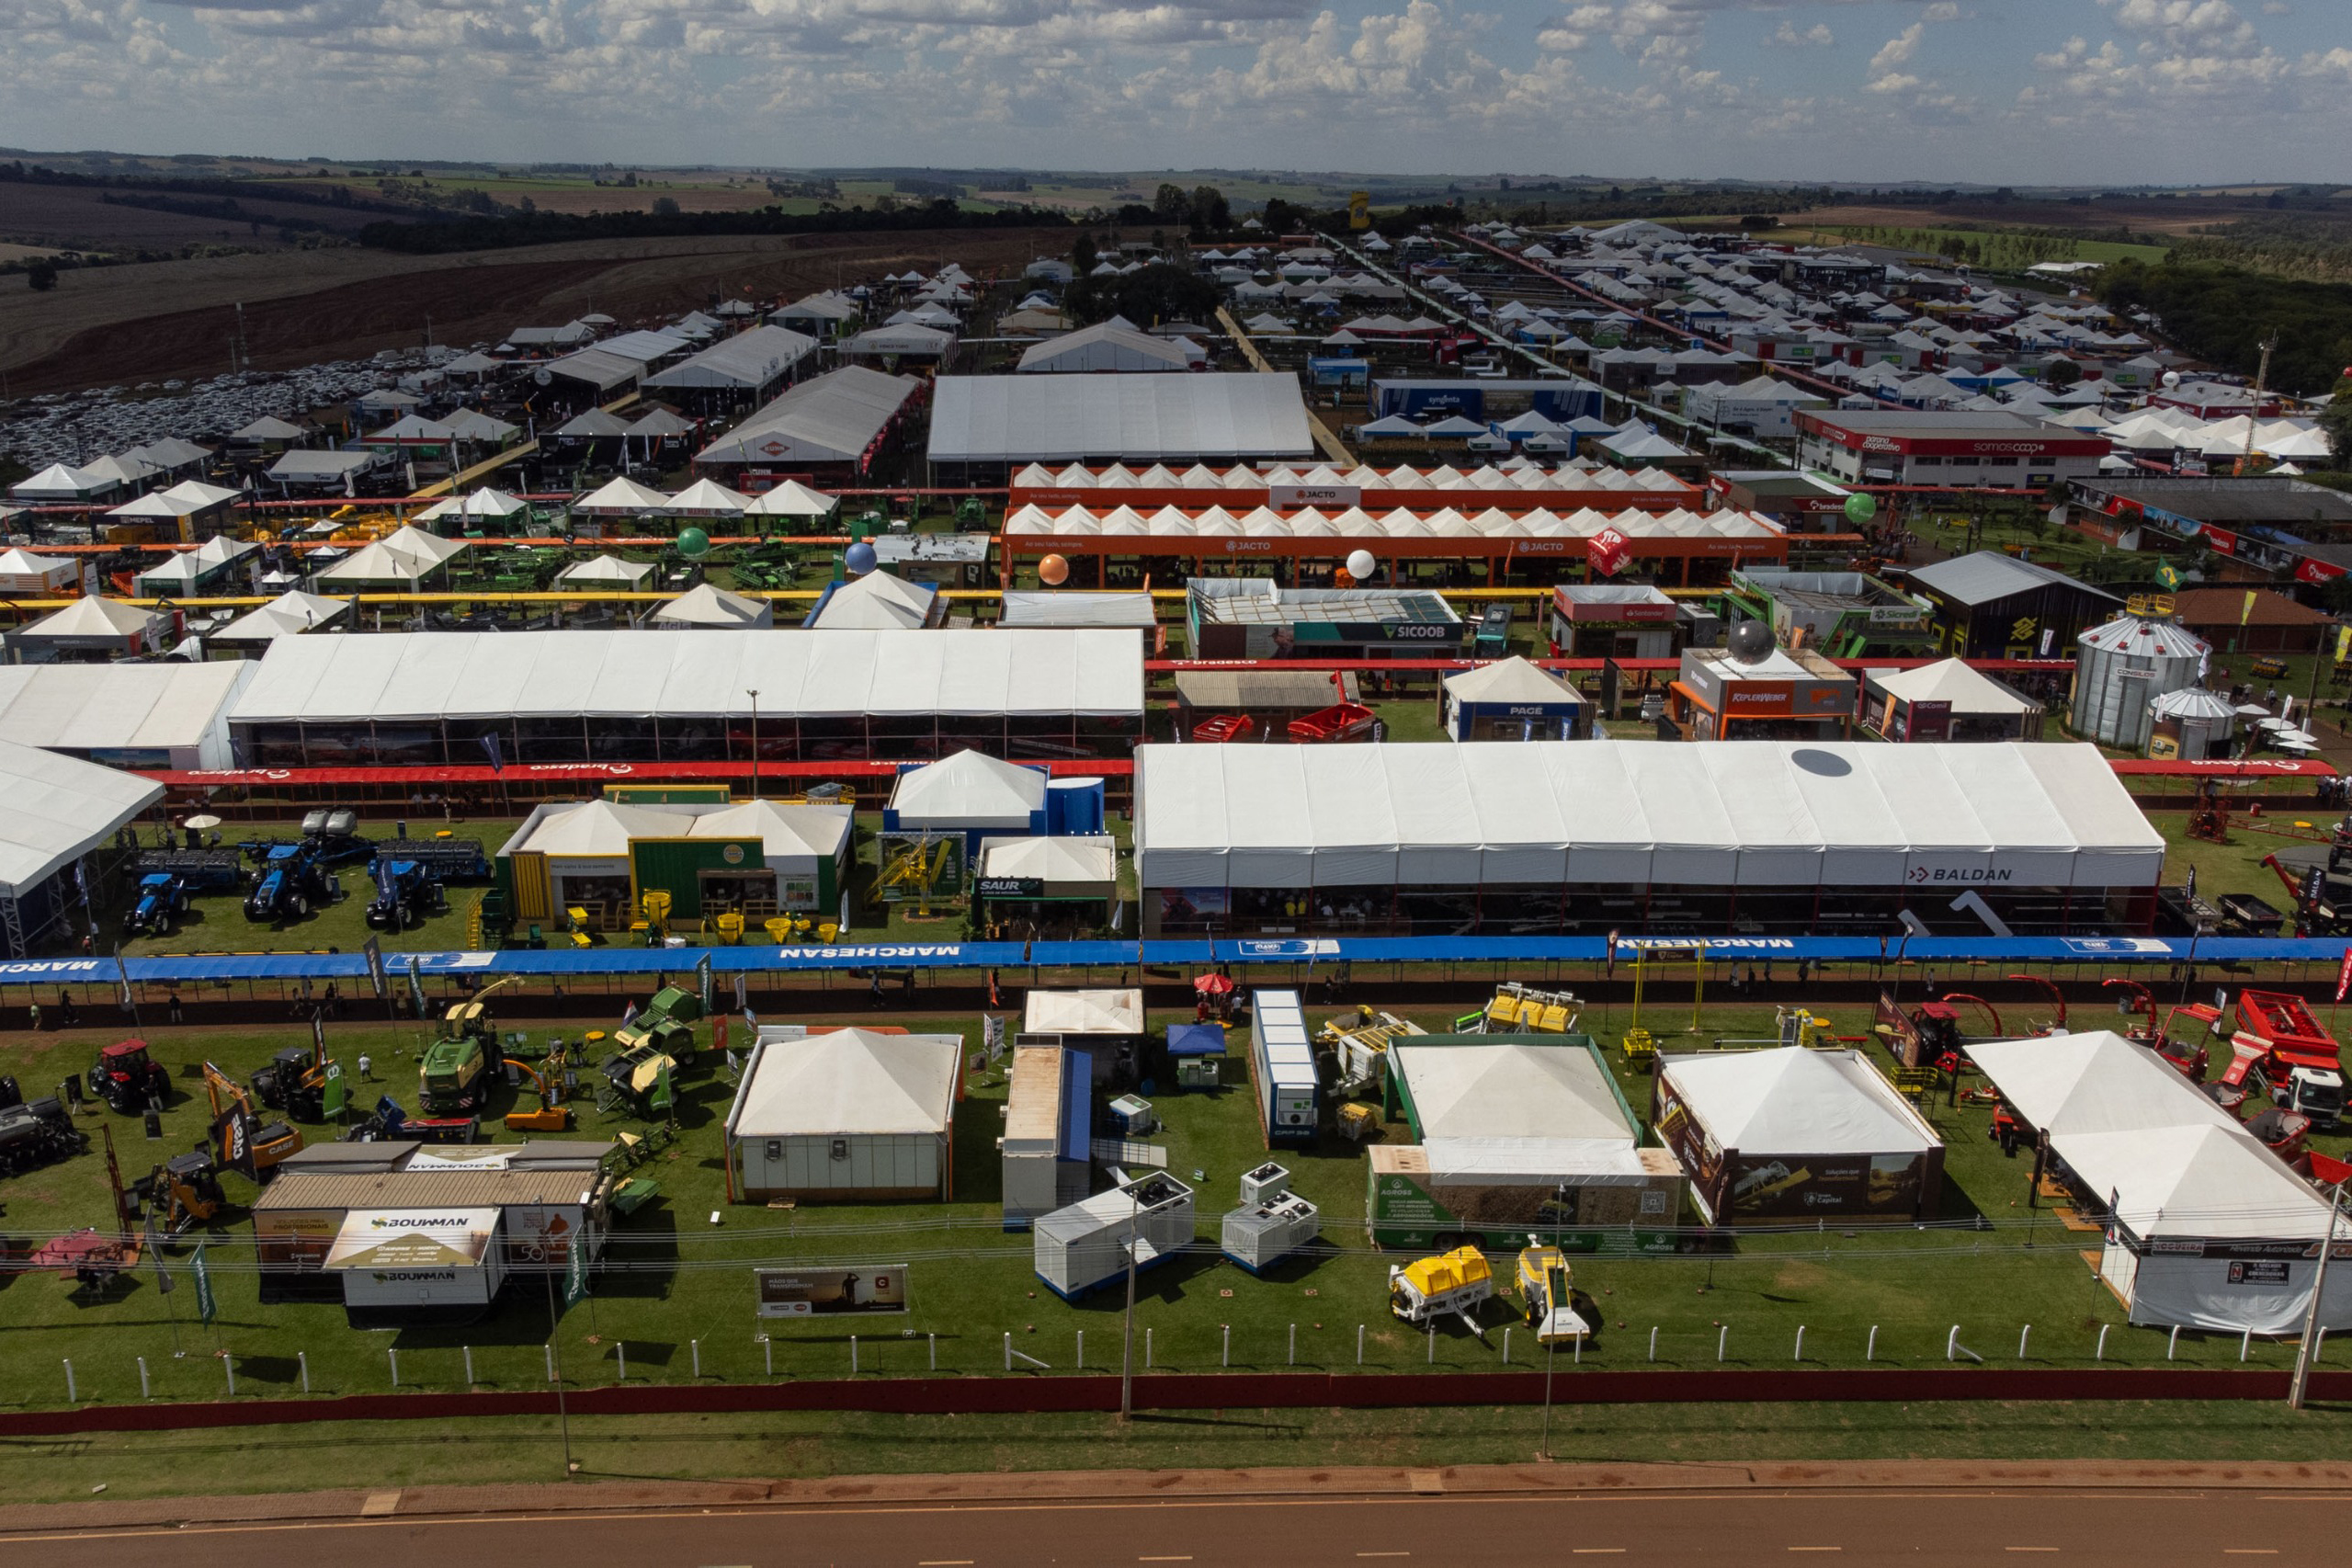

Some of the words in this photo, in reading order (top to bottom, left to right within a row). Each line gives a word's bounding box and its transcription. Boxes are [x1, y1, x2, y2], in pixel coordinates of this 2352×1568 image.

[1428, 395, 1460, 404] syngenta
[1862, 441, 1901, 451] cooperativo
[1973, 443, 2038, 455] somoscoop
[1306, 491, 1335, 499] JACTO
[1819, 503, 1846, 511] bradesc
[130, 517, 154, 526] MEPEL
[1237, 542, 1270, 551] JACTO
[1530, 542, 1564, 551] JACTO
[1885, 610, 1918, 619] Sicredi
[1397, 627, 1444, 638] SICOOB
[2117, 668, 2156, 677] CONSILOS
[1933, 869, 2013, 880] BALDAN
[980, 881, 1019, 891] SAUR
[779, 947, 960, 958] MARCHESAN
[269, 1141, 294, 1154] CASE
[388, 1218, 470, 1227] BOUWMAN
[2153, 1242, 2204, 1251] NOGUEIRA
[2230, 1244, 2262, 1253] Revenda
[389, 1272, 456, 1281] BOUWMAN
